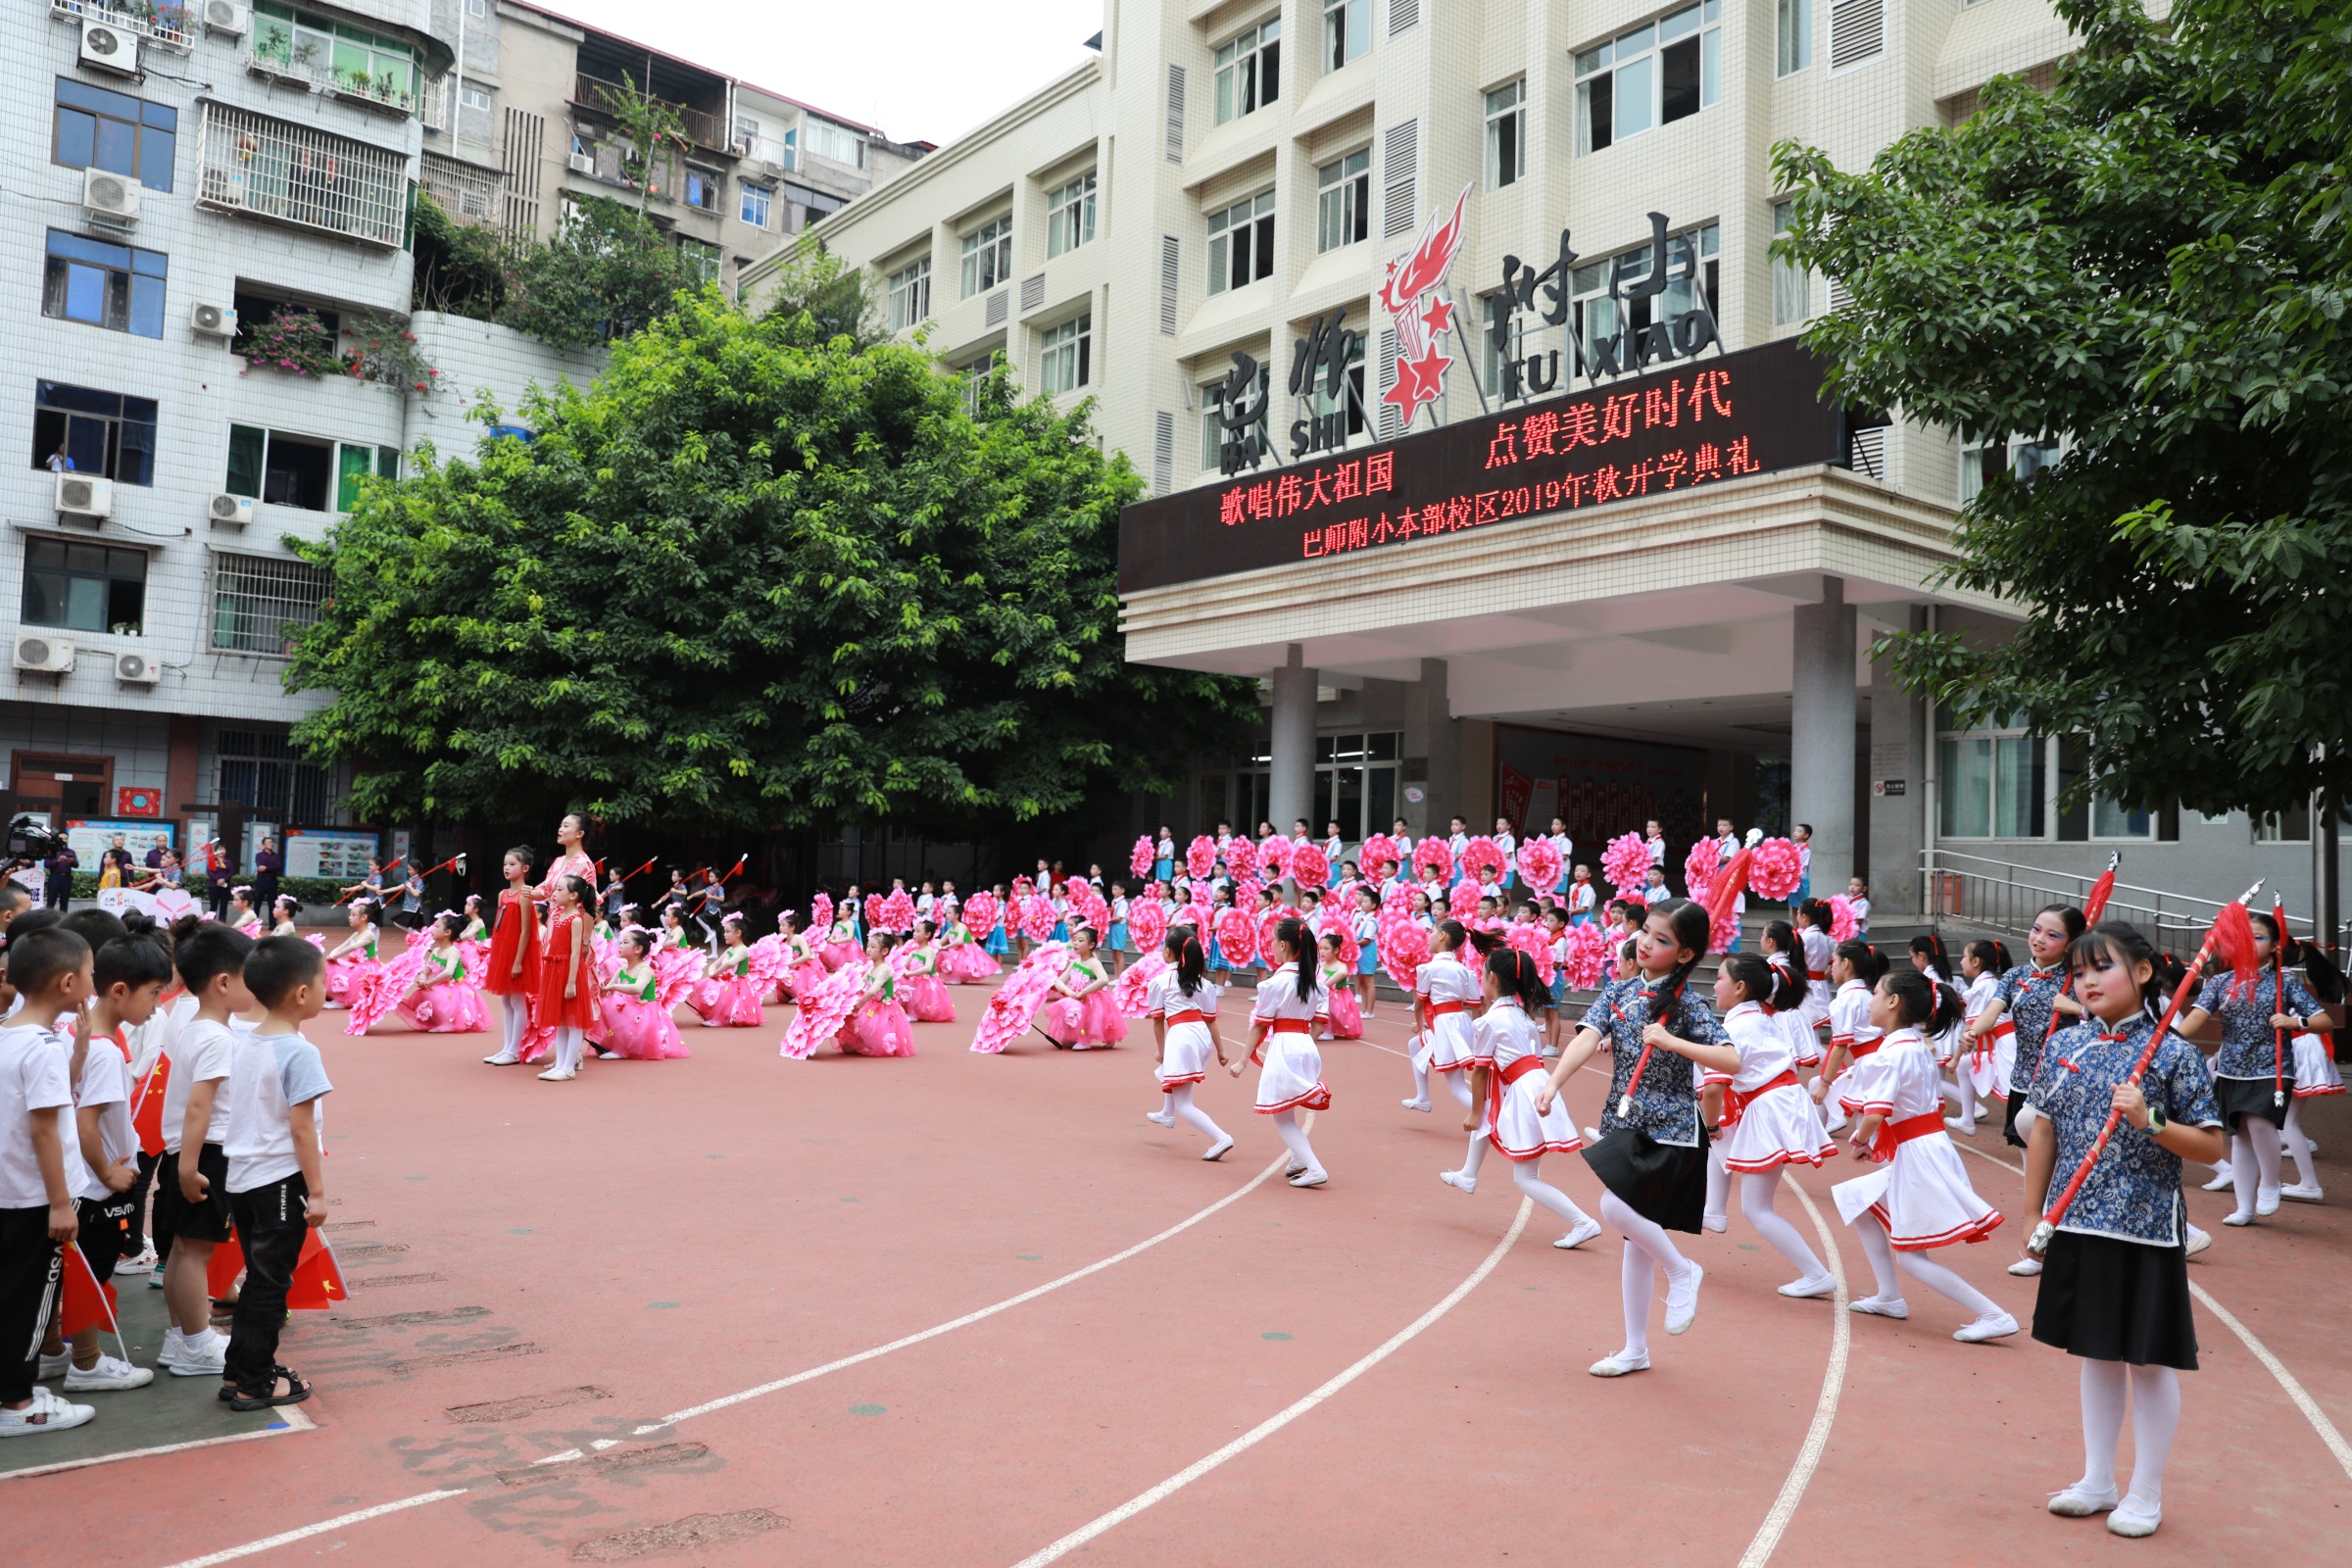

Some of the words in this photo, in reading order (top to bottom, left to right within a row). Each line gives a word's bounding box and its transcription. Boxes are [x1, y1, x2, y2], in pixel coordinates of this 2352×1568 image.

[1219, 307, 1356, 430] 巴师
[1493, 212, 1695, 352] 附小
[1220, 435, 1261, 475] BA
[1290, 411, 1346, 456] SHI
[1502, 350, 1557, 403] FU
[1592, 310, 1712, 379] XIAO
[1220, 451, 1395, 526] 歌唱伟大祖国
[1485, 370, 1733, 469] 点赞美好时代
[1303, 435, 1760, 559] 巴师附小本部校区2019年秋开学典礼
